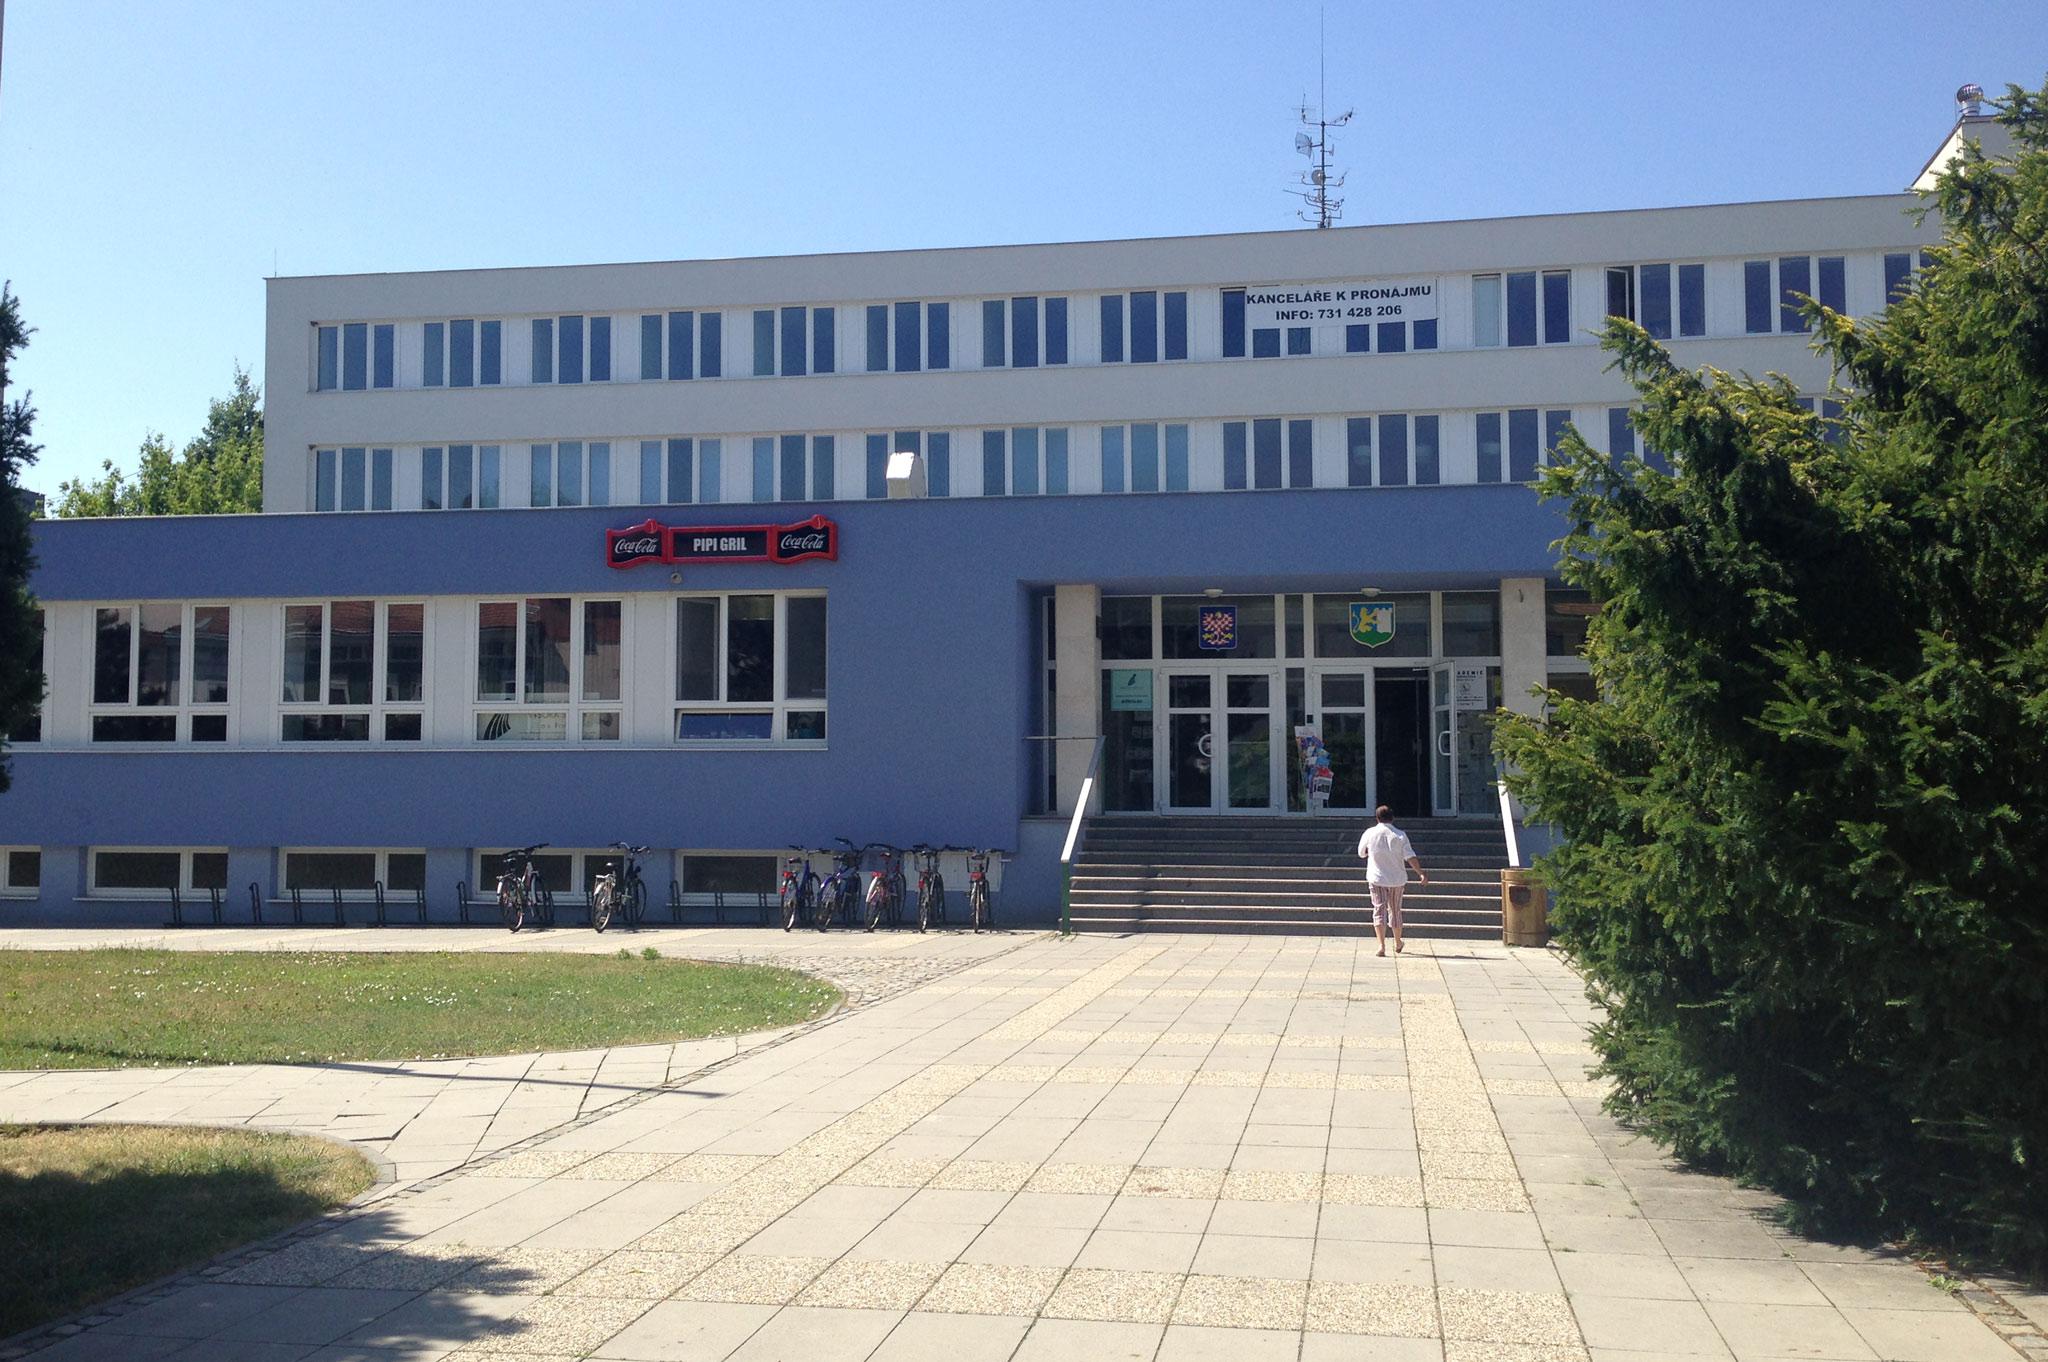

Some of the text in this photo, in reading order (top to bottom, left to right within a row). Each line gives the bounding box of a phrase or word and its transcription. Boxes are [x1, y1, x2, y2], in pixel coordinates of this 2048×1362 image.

[1247, 285, 1431, 304] KANCELÁŘE K PRONÁJMU
[1275, 305, 1402, 321] INFO: 731 428 206
[693, 537, 747, 552] PIPI GRIL
